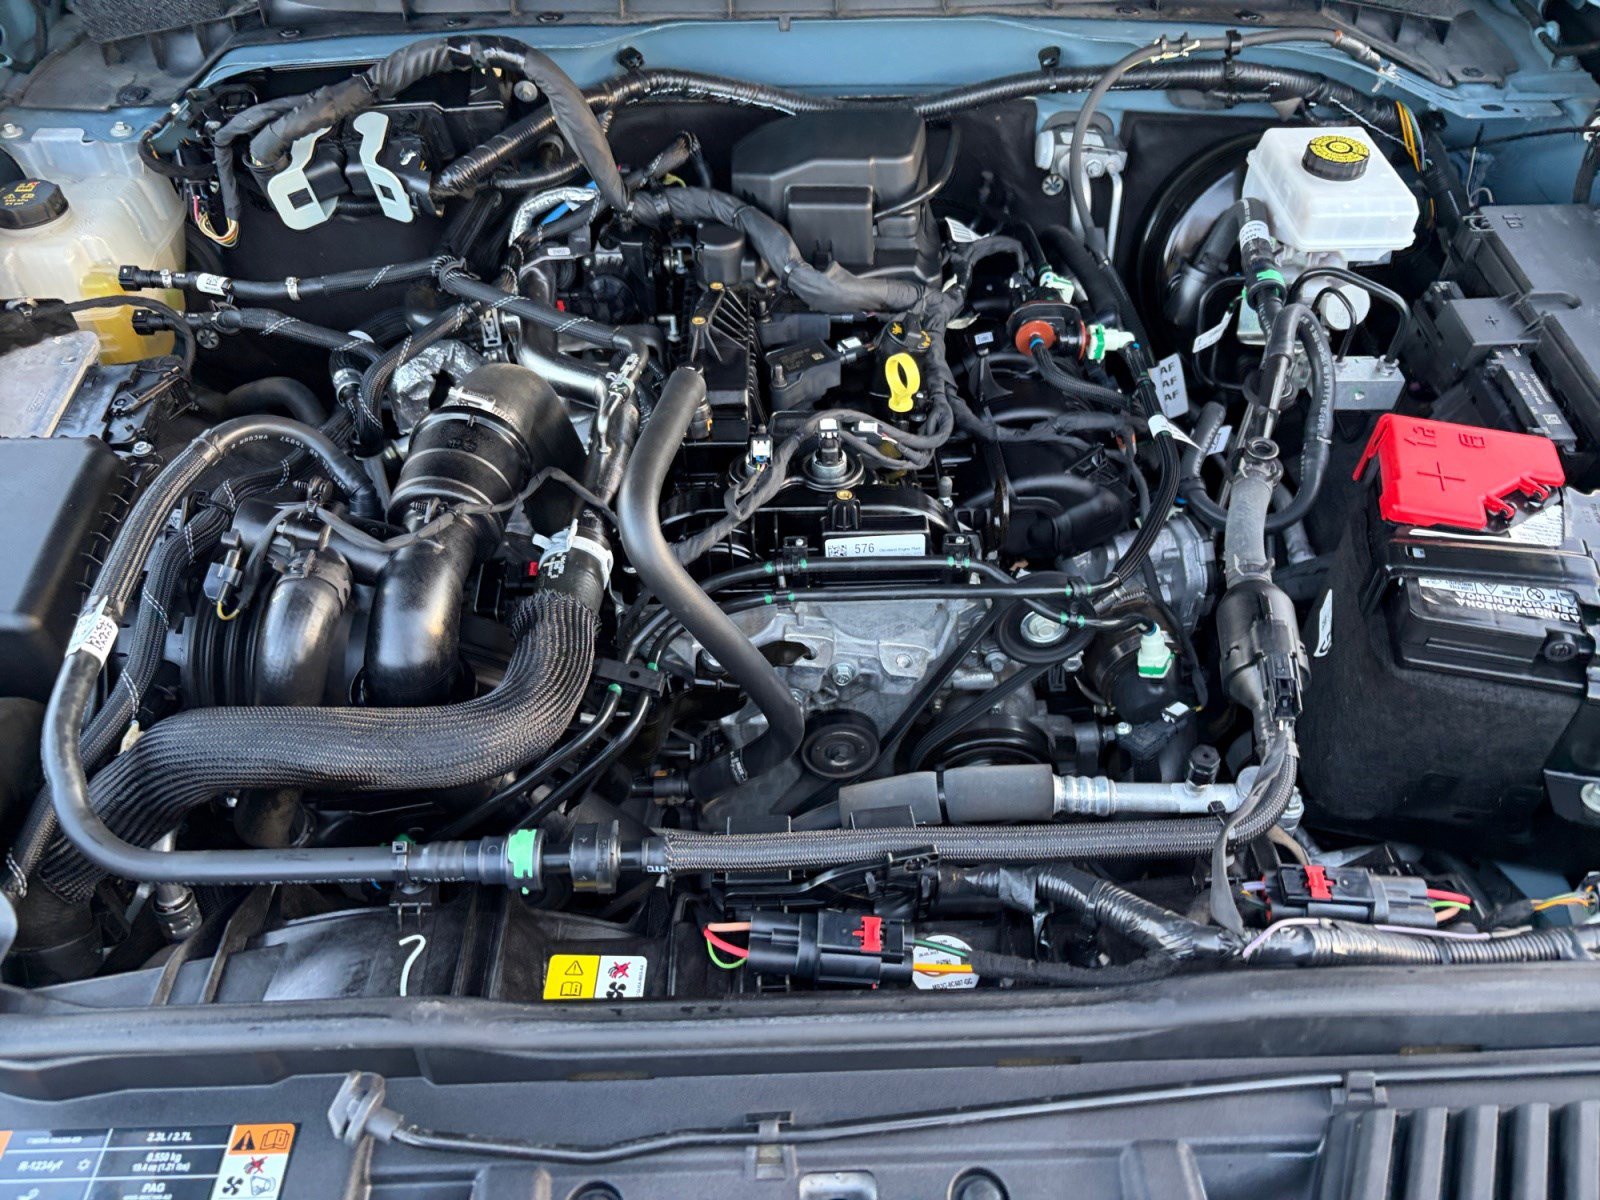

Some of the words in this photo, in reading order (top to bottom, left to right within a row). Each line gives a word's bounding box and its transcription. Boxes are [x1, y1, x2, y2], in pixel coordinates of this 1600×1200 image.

[1160, 361, 1175, 376] AF
[1162, 376, 1177, 389] AF
[1164, 390, 1179, 402] AF
[854, 543, 875, 554] 576
[1466, 600, 1571, 621] DANGER/POISON
[173, 1132, 192, 1142] 2.7L
[141, 1181, 166, 1193] PAG
